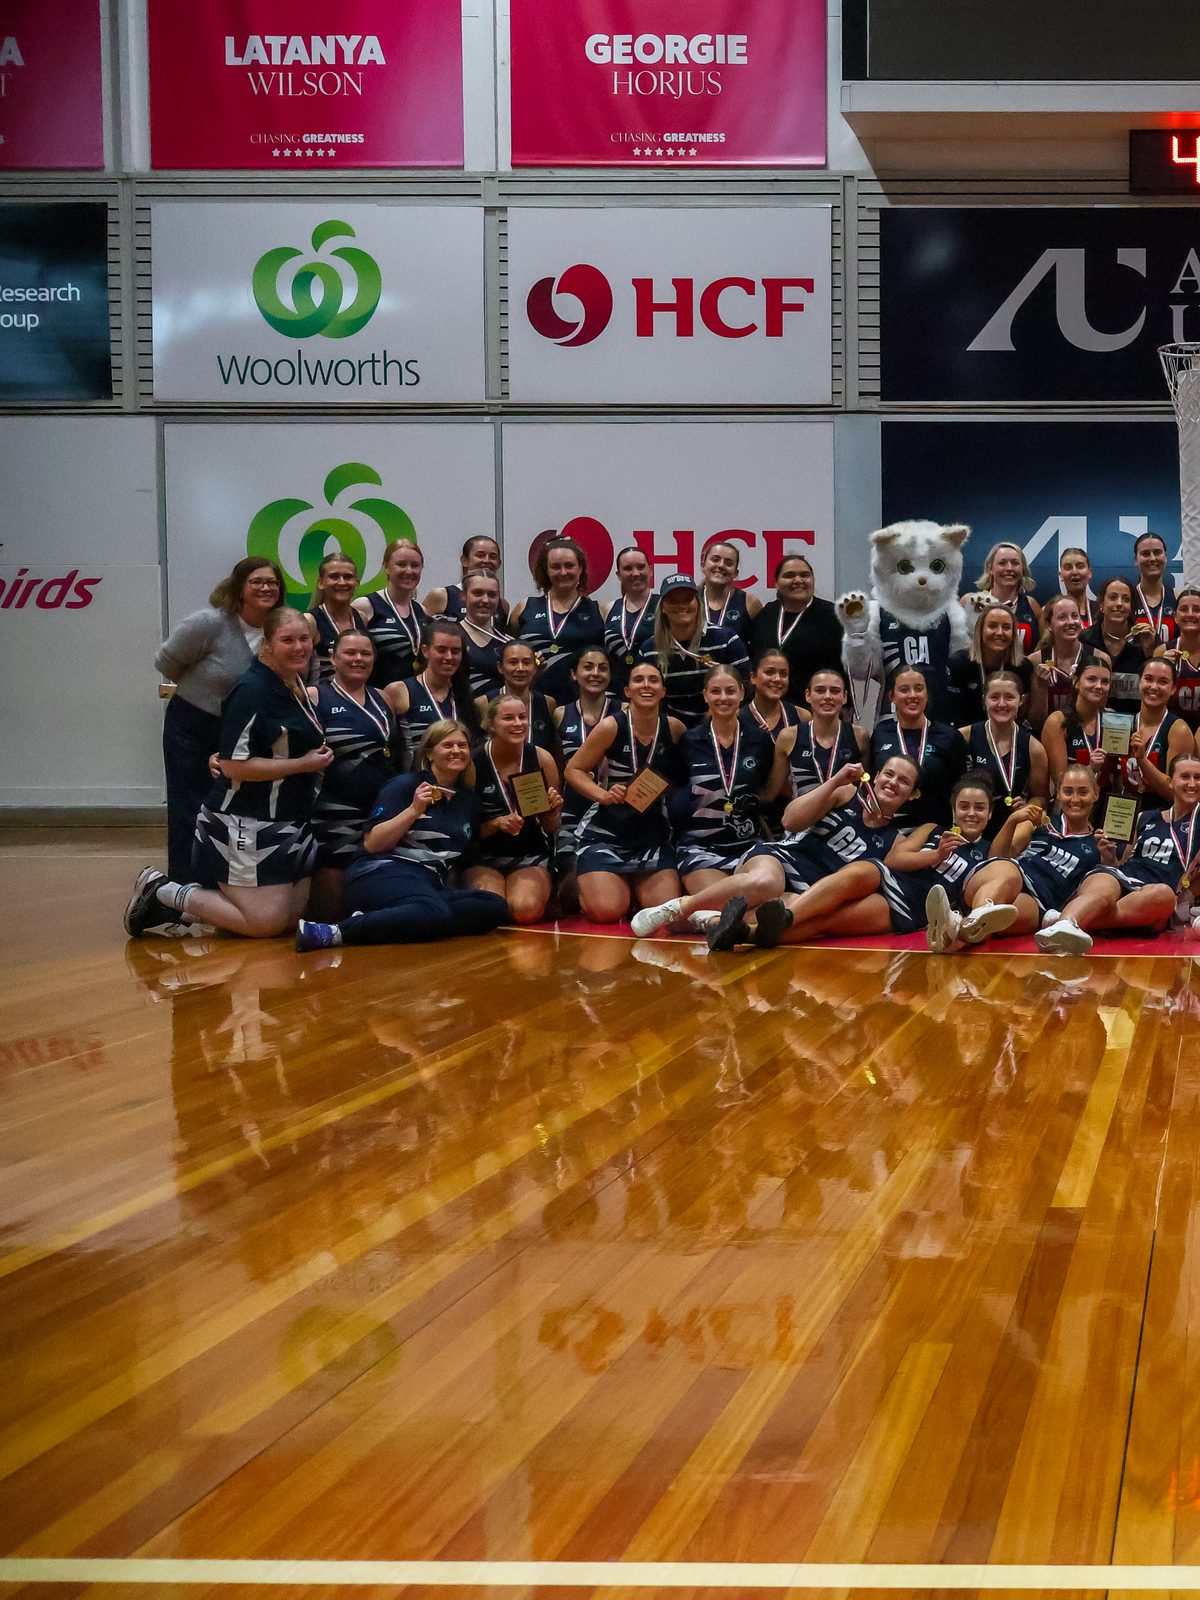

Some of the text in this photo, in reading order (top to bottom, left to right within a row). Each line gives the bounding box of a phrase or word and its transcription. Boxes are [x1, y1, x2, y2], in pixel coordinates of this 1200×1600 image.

[224, 35, 386, 66] LATANYA
[585, 34, 748, 66] GEORGIE
[247, 71, 363, 96] WILSON
[612, 71, 722, 99] HORJUS
[250, 133, 364, 144] CHASING GREATNESS
[611, 132, 726, 144] CHASING GREATNESS
[0, 282, 81, 302] esearch
[632, 276, 815, 338] HCF
[217, 349, 421, 387] Woolworths
[903, 635, 930, 665] GA
[826, 825, 868, 863] GD
[1140, 835, 1175, 865] GA
